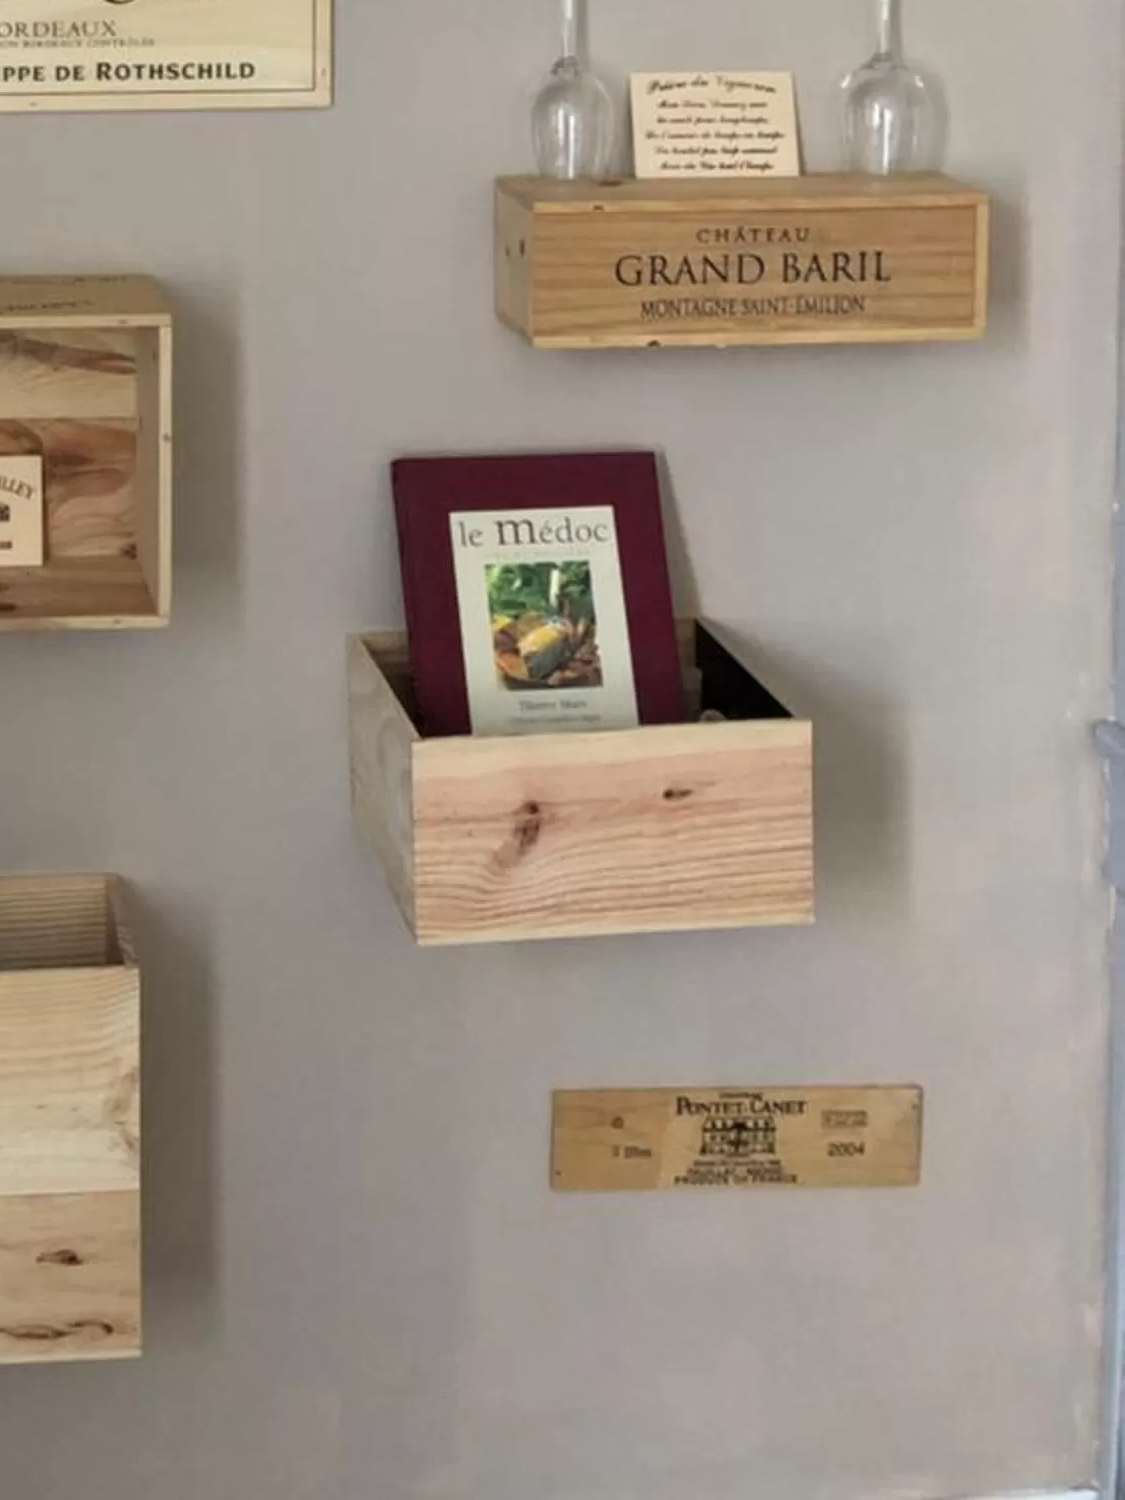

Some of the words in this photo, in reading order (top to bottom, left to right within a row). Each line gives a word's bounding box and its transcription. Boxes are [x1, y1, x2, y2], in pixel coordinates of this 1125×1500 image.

[55, 64, 86, 83] DE
[95, 61, 257, 82] ROTHSCHILD
[613, 253, 766, 287] GRAND
[781, 250, 892, 284] BARIL
[640, 299, 738, 320] MONTAGNE
[457, 520, 484, 548] le
